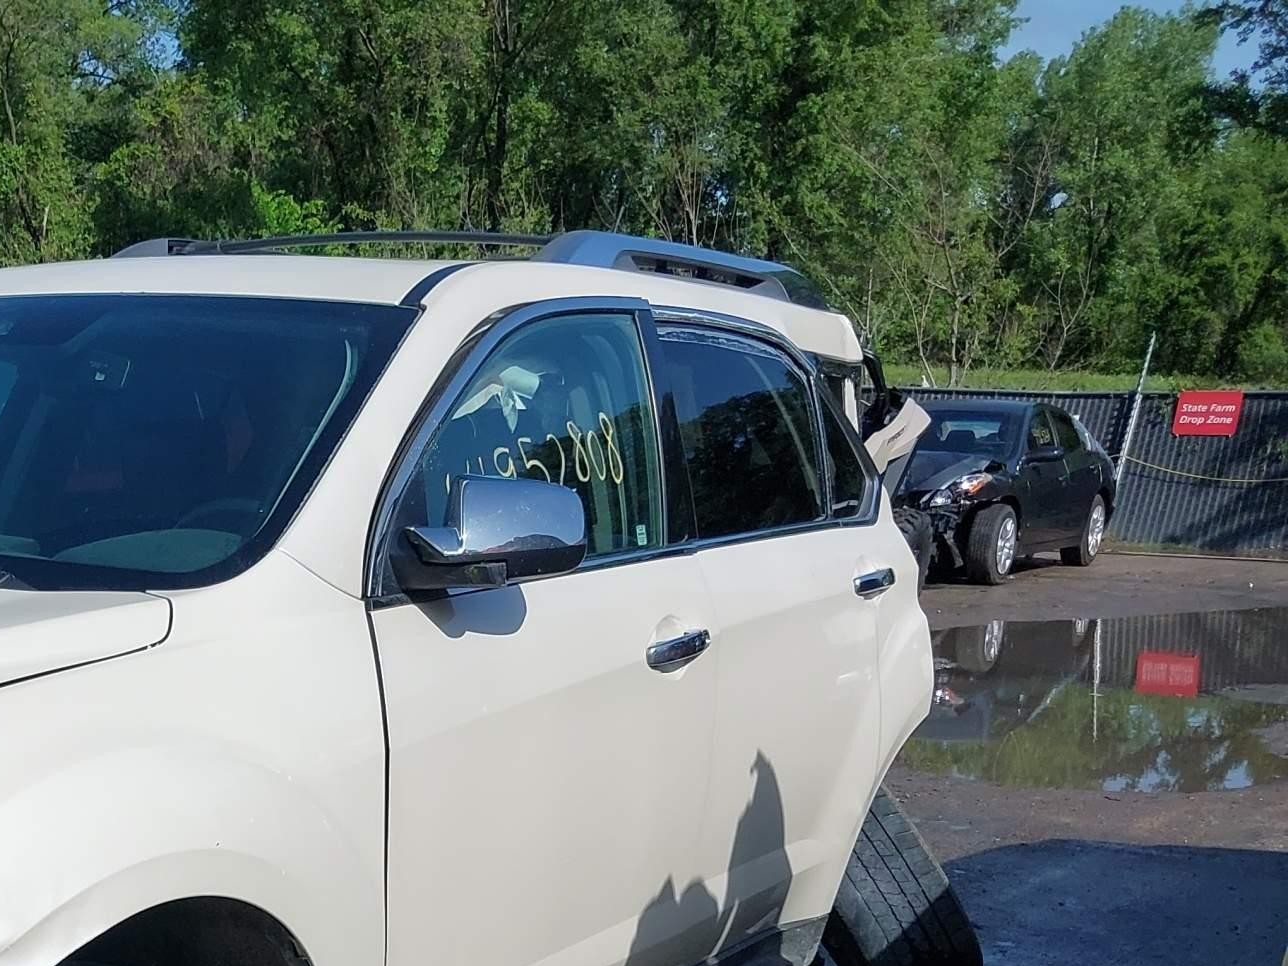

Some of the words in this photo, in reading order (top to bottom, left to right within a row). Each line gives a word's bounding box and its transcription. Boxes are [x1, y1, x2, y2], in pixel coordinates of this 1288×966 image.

[1181, 403, 1208, 412] State
[1210, 403, 1236, 412] Farm
[1179, 415, 1205, 426] Drop
[1206, 415, 1233, 424] Zone
